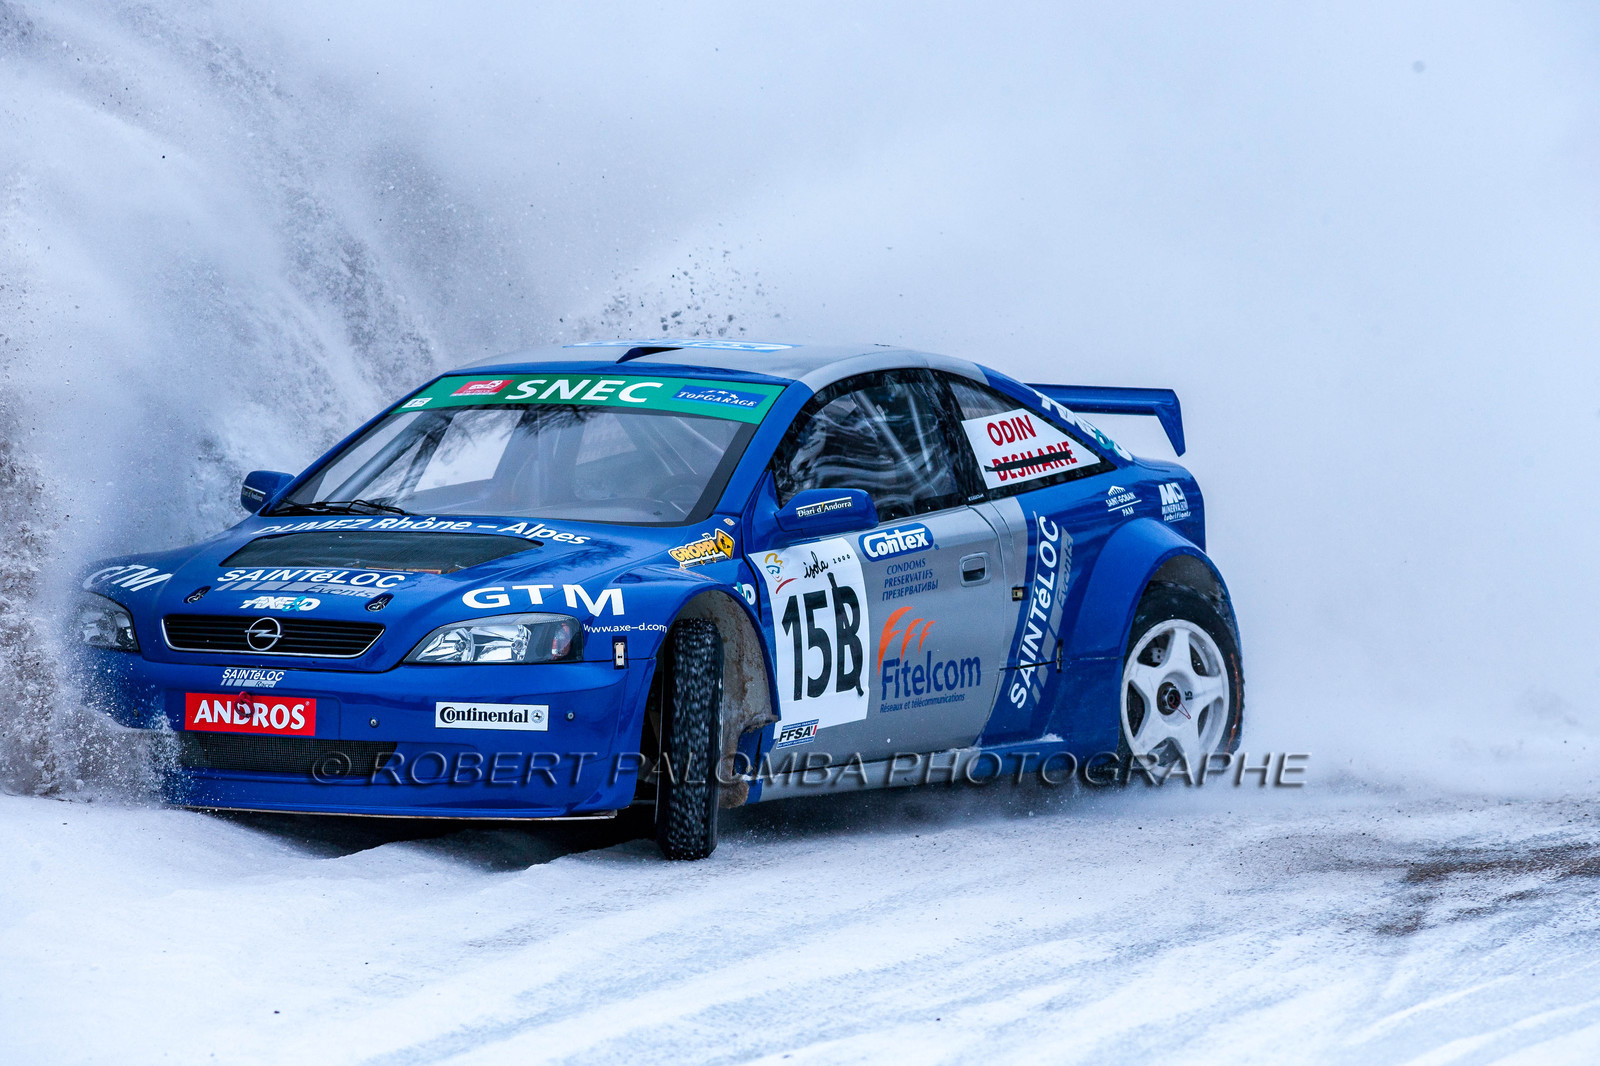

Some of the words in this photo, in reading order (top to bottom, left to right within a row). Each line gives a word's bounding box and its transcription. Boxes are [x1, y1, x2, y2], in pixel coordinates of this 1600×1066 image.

[505, 379, 664, 403] SNEC
[987, 414, 1037, 447] ODIN
[797, 507, 816, 517] Diari
[250, 518, 369, 535] DUMEZ
[369, 516, 473, 530] Rhône
[497, 521, 591, 544] Alpes
[670, 539, 719, 562] GROPPI
[863, 528, 929, 558] Contex
[886, 558, 926, 575] CONDOMS
[884, 569, 933, 588] PRESERVATIFS
[462, 584, 625, 617] GTM
[882, 580, 939, 601] ПРЕЗЕРВАТИВЫ
[881, 650, 982, 701] Fitelcom
[193, 699, 306, 730] ANDROS
[440, 706, 529, 723] Continental
[903, 700, 911, 710] et
